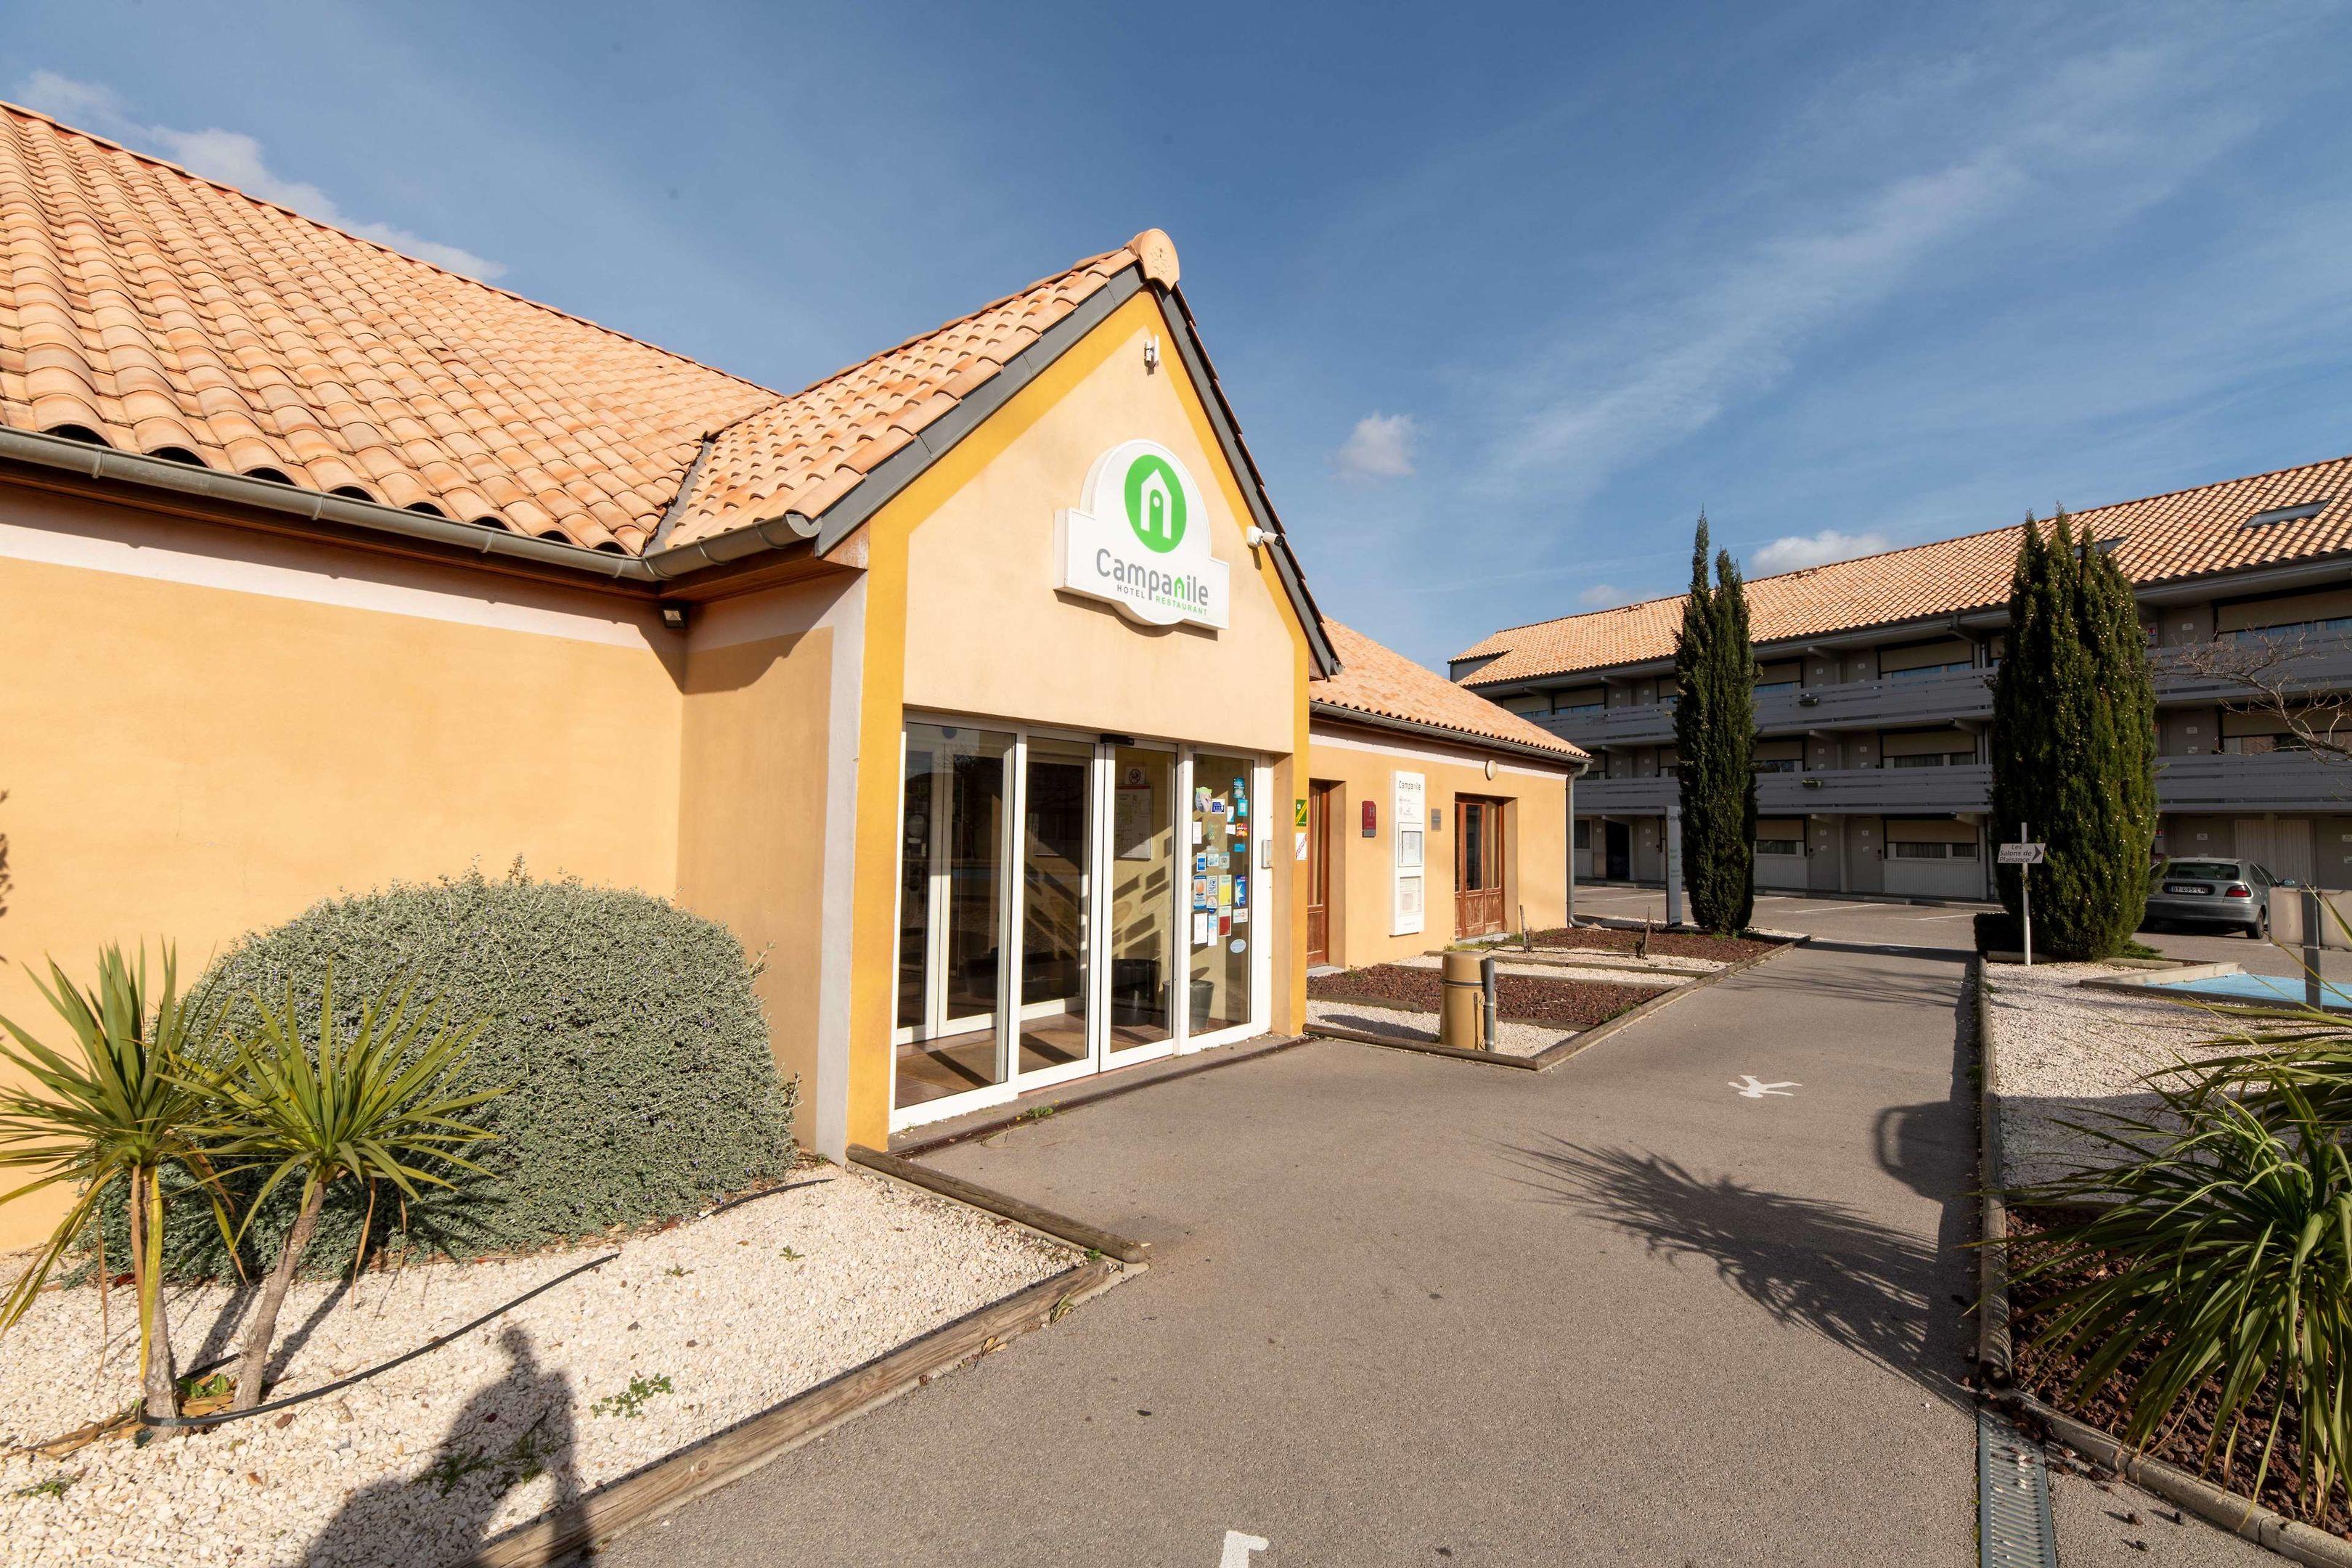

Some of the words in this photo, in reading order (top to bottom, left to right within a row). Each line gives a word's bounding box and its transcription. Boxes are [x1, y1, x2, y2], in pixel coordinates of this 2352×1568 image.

[1096, 548, 1208, 605] Campanile
[1116, 584, 1146, 599] HOTEL
[1156, 595, 1208, 616] RESTAURANT
